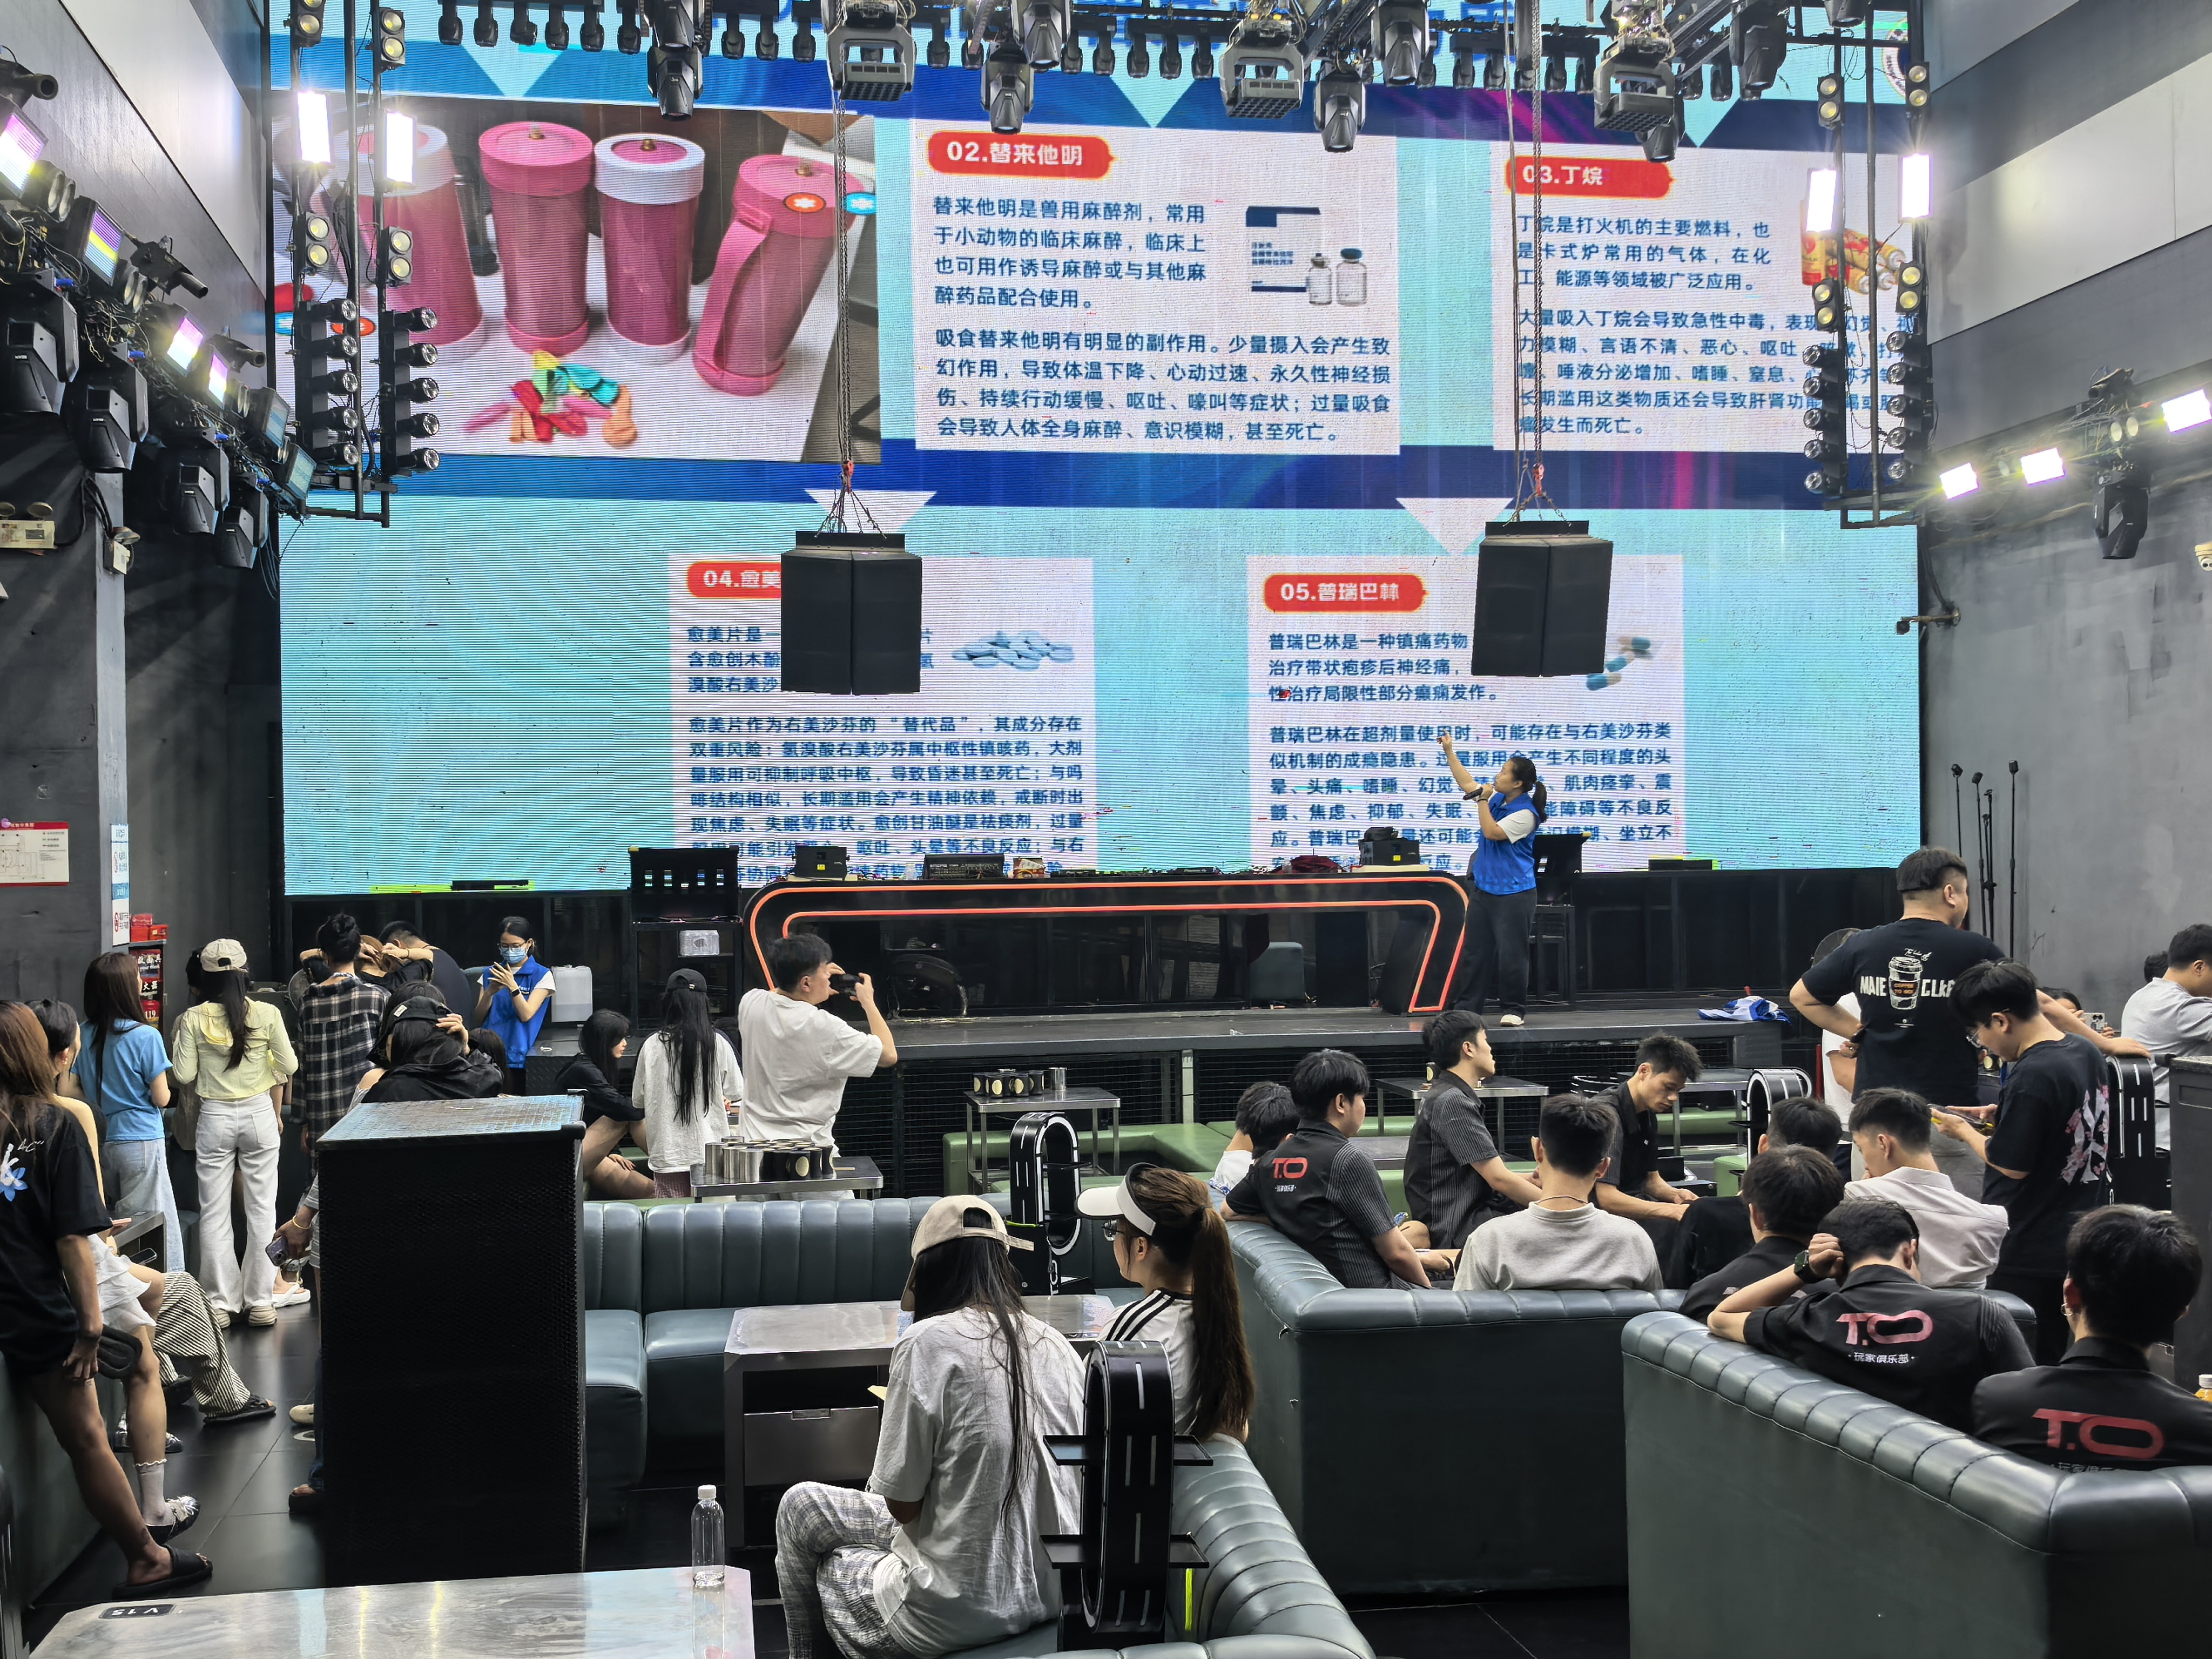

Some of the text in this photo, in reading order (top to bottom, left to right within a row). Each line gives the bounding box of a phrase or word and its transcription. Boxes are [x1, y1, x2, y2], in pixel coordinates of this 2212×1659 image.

[947, 141, 1083, 166] 02.替来他明
[1522, 165, 1603, 185] 03.丁烷
[936, 258, 1206, 281] 也可用作诱导麻醉或与其他麻
[936, 287, 1091, 308] 醉药品配合使用。
[1280, 583, 1400, 602] 05.普瑞巴林
[1270, 633, 1468, 650] 普瑞巴林是一种镇痛药物
[2032, 1408, 2164, 1460] T.O
